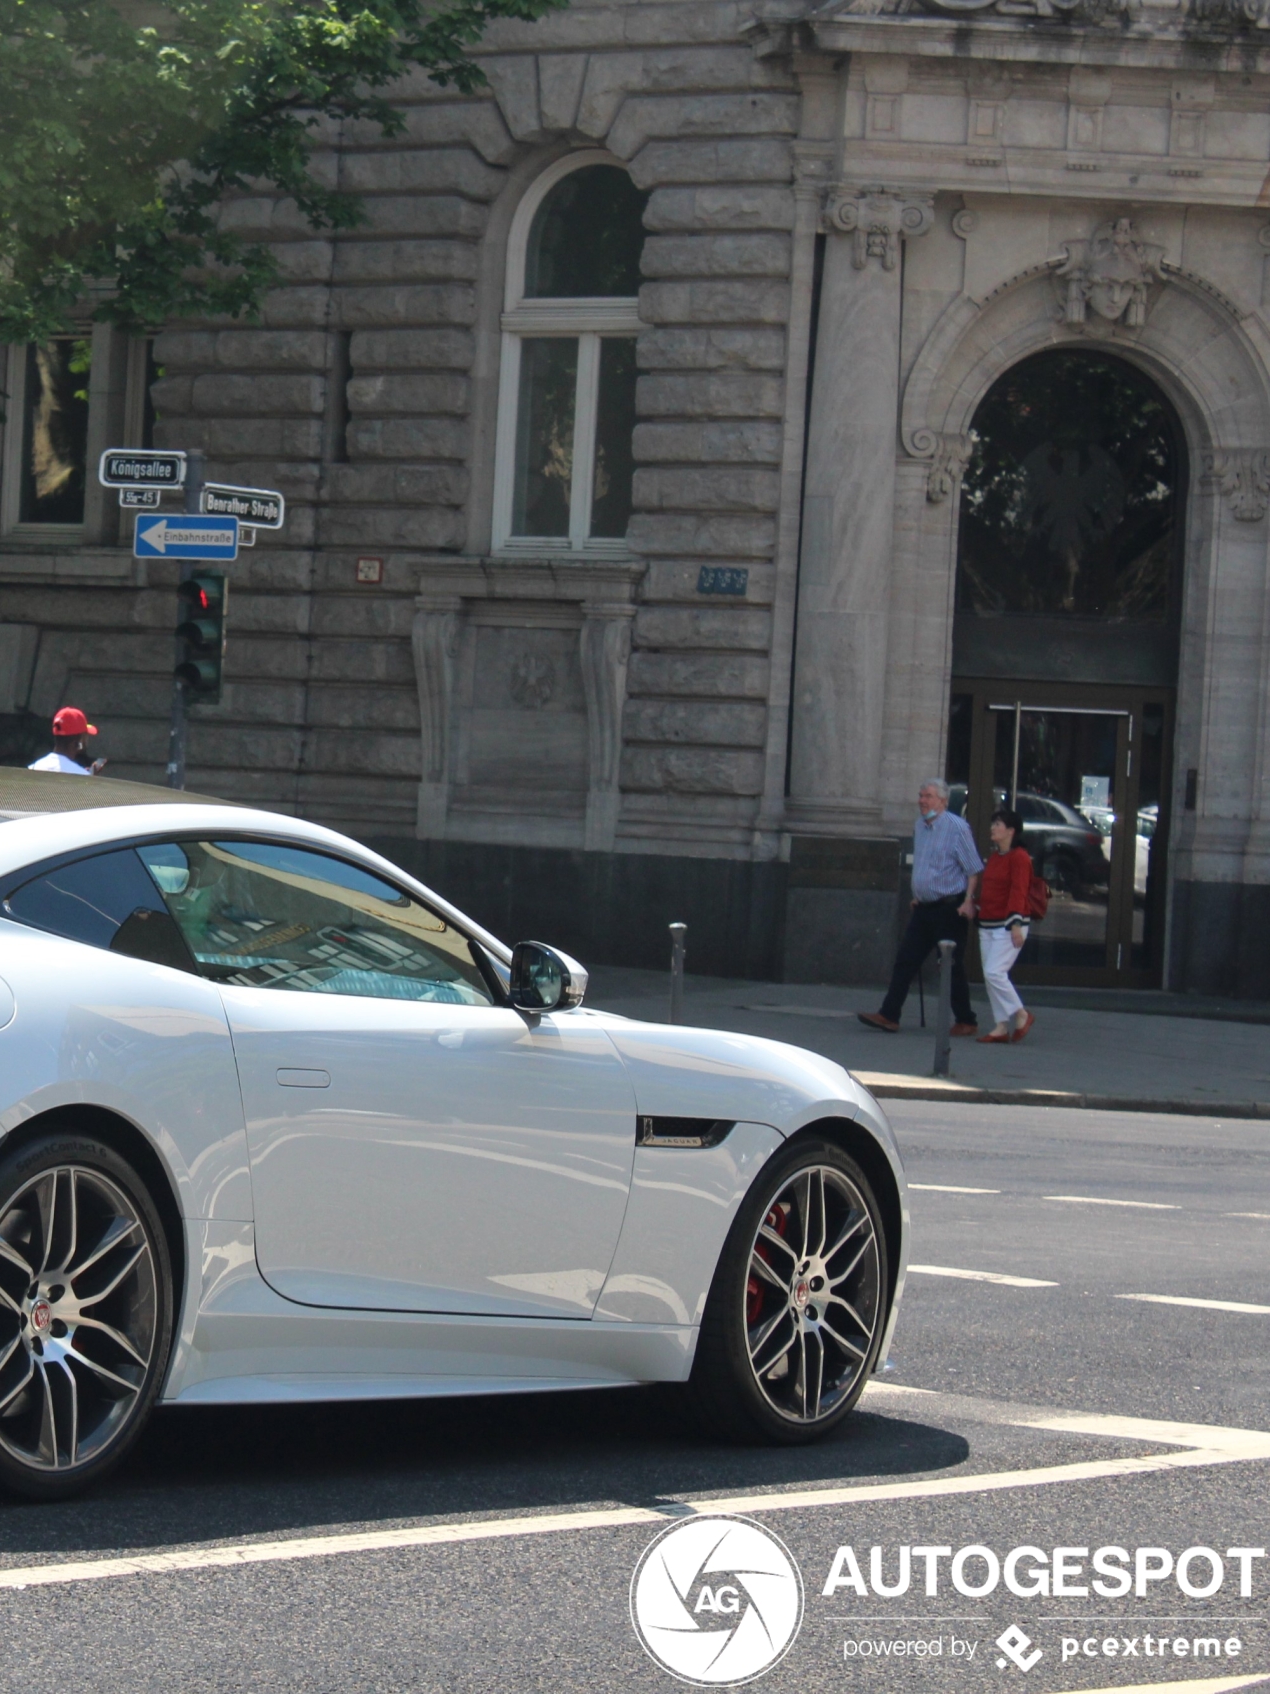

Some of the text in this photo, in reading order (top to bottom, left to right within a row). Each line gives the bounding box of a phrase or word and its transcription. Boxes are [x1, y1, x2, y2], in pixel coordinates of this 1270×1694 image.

[111, 459, 172, 479] Königsallee
[207, 494, 278, 520] Benrather Straße
[164, 531, 232, 544] Einbahnstraße
[16, 1141, 107, 1172] SportContact 6
